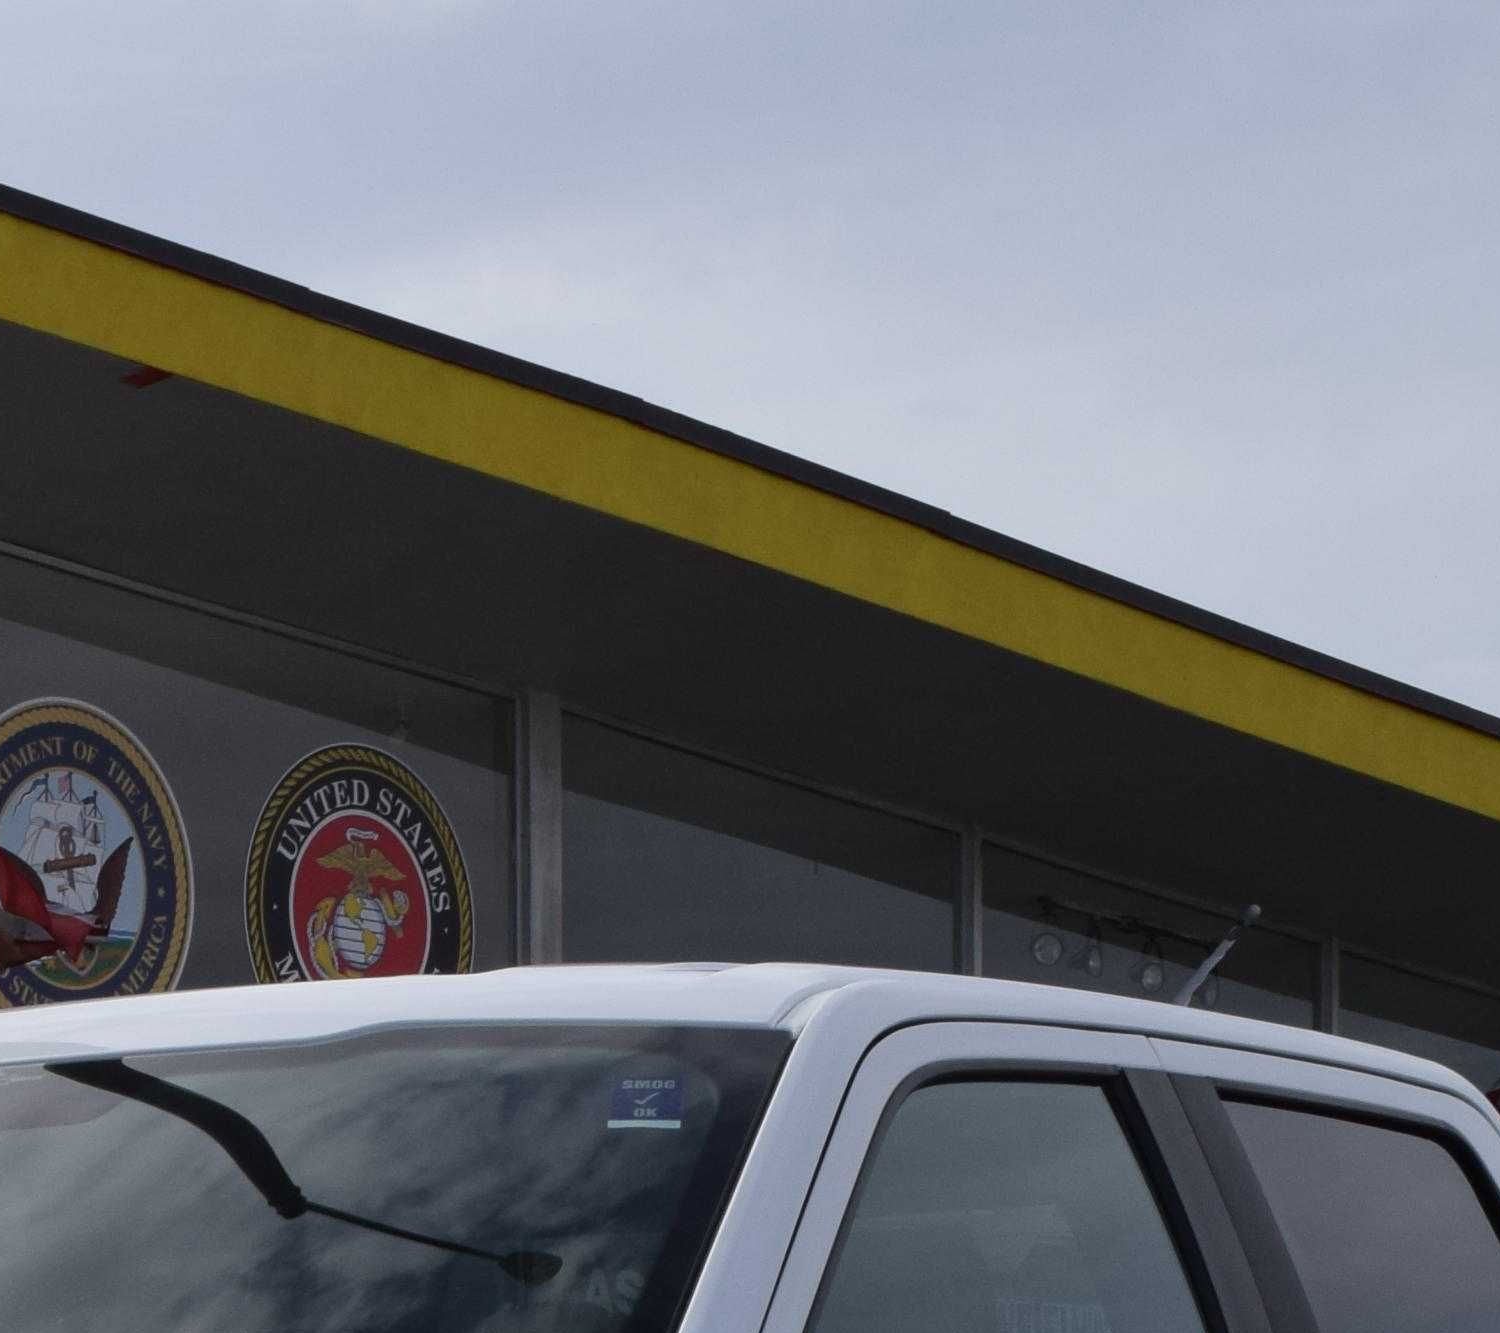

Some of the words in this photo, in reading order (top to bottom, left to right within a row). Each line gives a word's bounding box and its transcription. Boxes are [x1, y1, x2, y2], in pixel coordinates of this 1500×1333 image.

[73, 739, 98, 763] OF
[108, 757, 142, 802] THE
[137, 805, 169, 871] NAVY
[277, 779, 370, 861] UNITED
[376, 787, 450, 914] STATES
[622, 1079, 676, 1090] SMOG
[633, 1108, 658, 1118] OK
